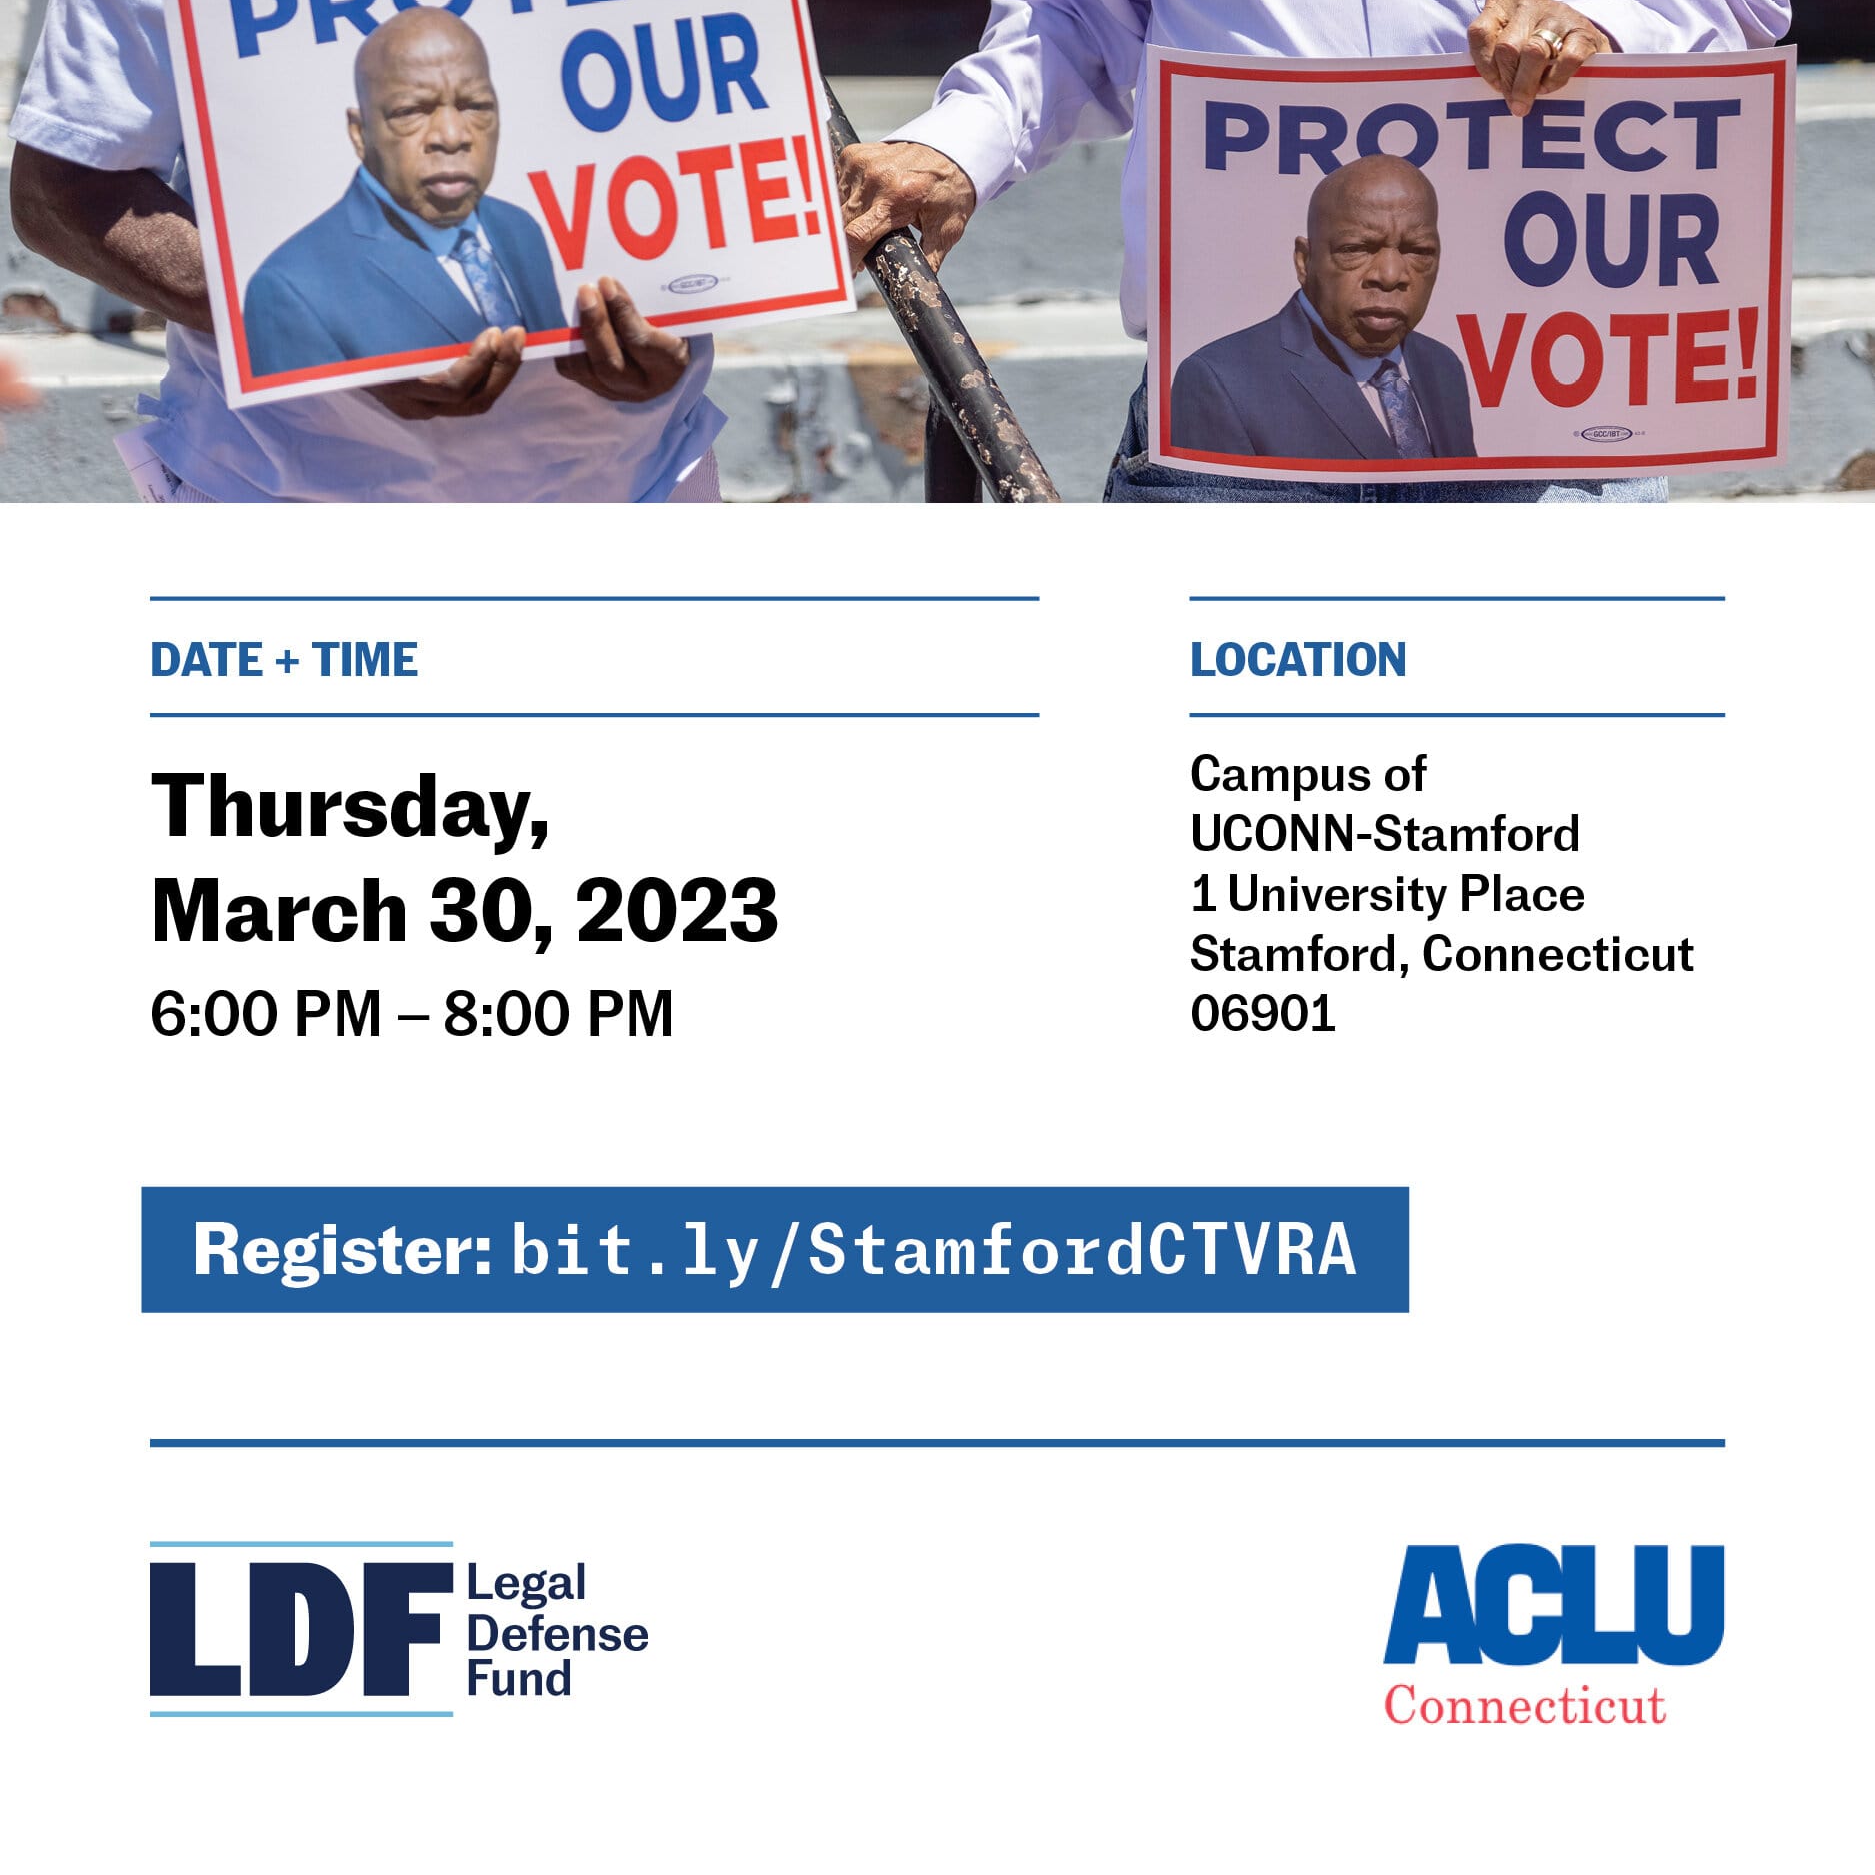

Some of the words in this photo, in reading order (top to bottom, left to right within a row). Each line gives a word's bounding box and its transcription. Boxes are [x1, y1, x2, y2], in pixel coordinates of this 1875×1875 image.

[561, 12, 769, 133] OUR
[1204, 98, 1741, 175] PROTECT
[527, 135, 822, 271] VOTE!
[1504, 190, 1720, 288] OUR
[1457, 306, 1758, 408] VOTE!
[152, 642, 263, 677] DATE
[276, 650, 300, 673] +
[312, 642, 418, 677] TIME
[1192, 642, 1406, 677] LOCATION
[1191, 754, 1371, 801] Campus
[1385, 754, 1428, 791] of
[151, 773, 547, 855] Thursday,
[1192, 813, 1578, 853] UCONN-Stamford
[155, 877, 405, 942] March
[430, 877, 552, 954] 30,
[577, 877, 778, 942] 2023
[1193, 874, 1216, 911] 1
[1229, 873, 1447, 923] University
[1461, 874, 1584, 912] Place
[1191, 933, 1408, 978] Stamford,
[1423, 934, 1694, 973] Connecticut
[152, 990, 277, 1037] 6:00
[297, 989, 379, 1037] PM
[445, 990, 569, 1037] 8:00
[590, 989, 672, 1037] PM
[1192, 994, 1336, 1031] 06901
[195, 1221, 490, 1288] Register:
[514, 1221, 1357, 1289] bit.ly/StamfordCTVRA
[468, 1562, 585, 1610] Legal
[1383, 1543, 1725, 1667] ACLU
[150, 1562, 454, 1697] LDF
[468, 1614, 648, 1651] Defense
[468, 1659, 570, 1696] Fund
[1385, 1683, 1666, 1725] Connecticut
